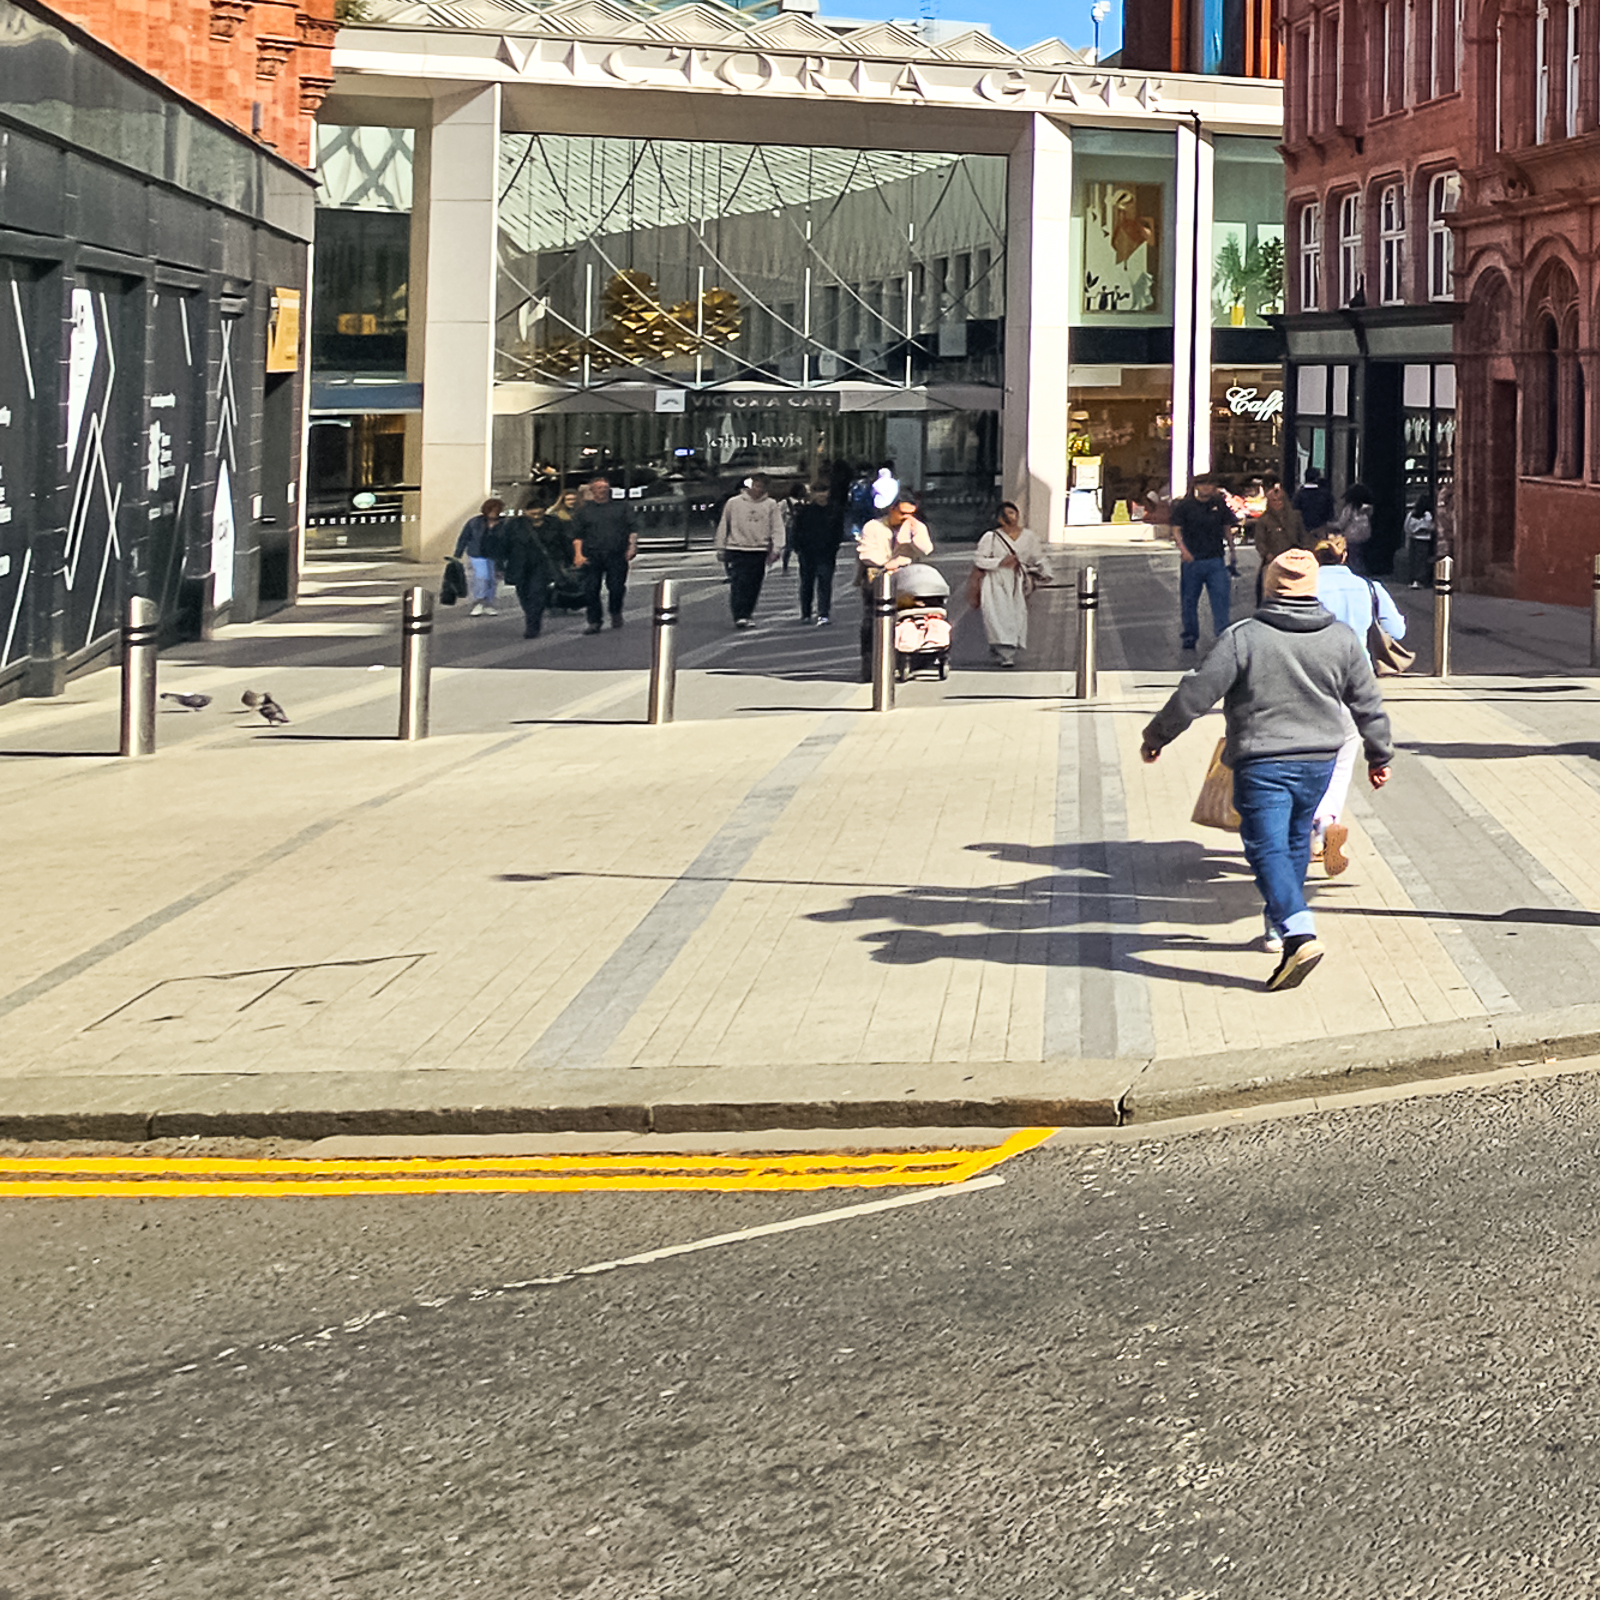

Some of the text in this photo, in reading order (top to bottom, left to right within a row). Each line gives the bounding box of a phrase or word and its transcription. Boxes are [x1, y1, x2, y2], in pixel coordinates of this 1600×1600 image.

[496, 34, 1167, 111] VICTORIA GATE
[706, 431, 803, 448] John Lewis
